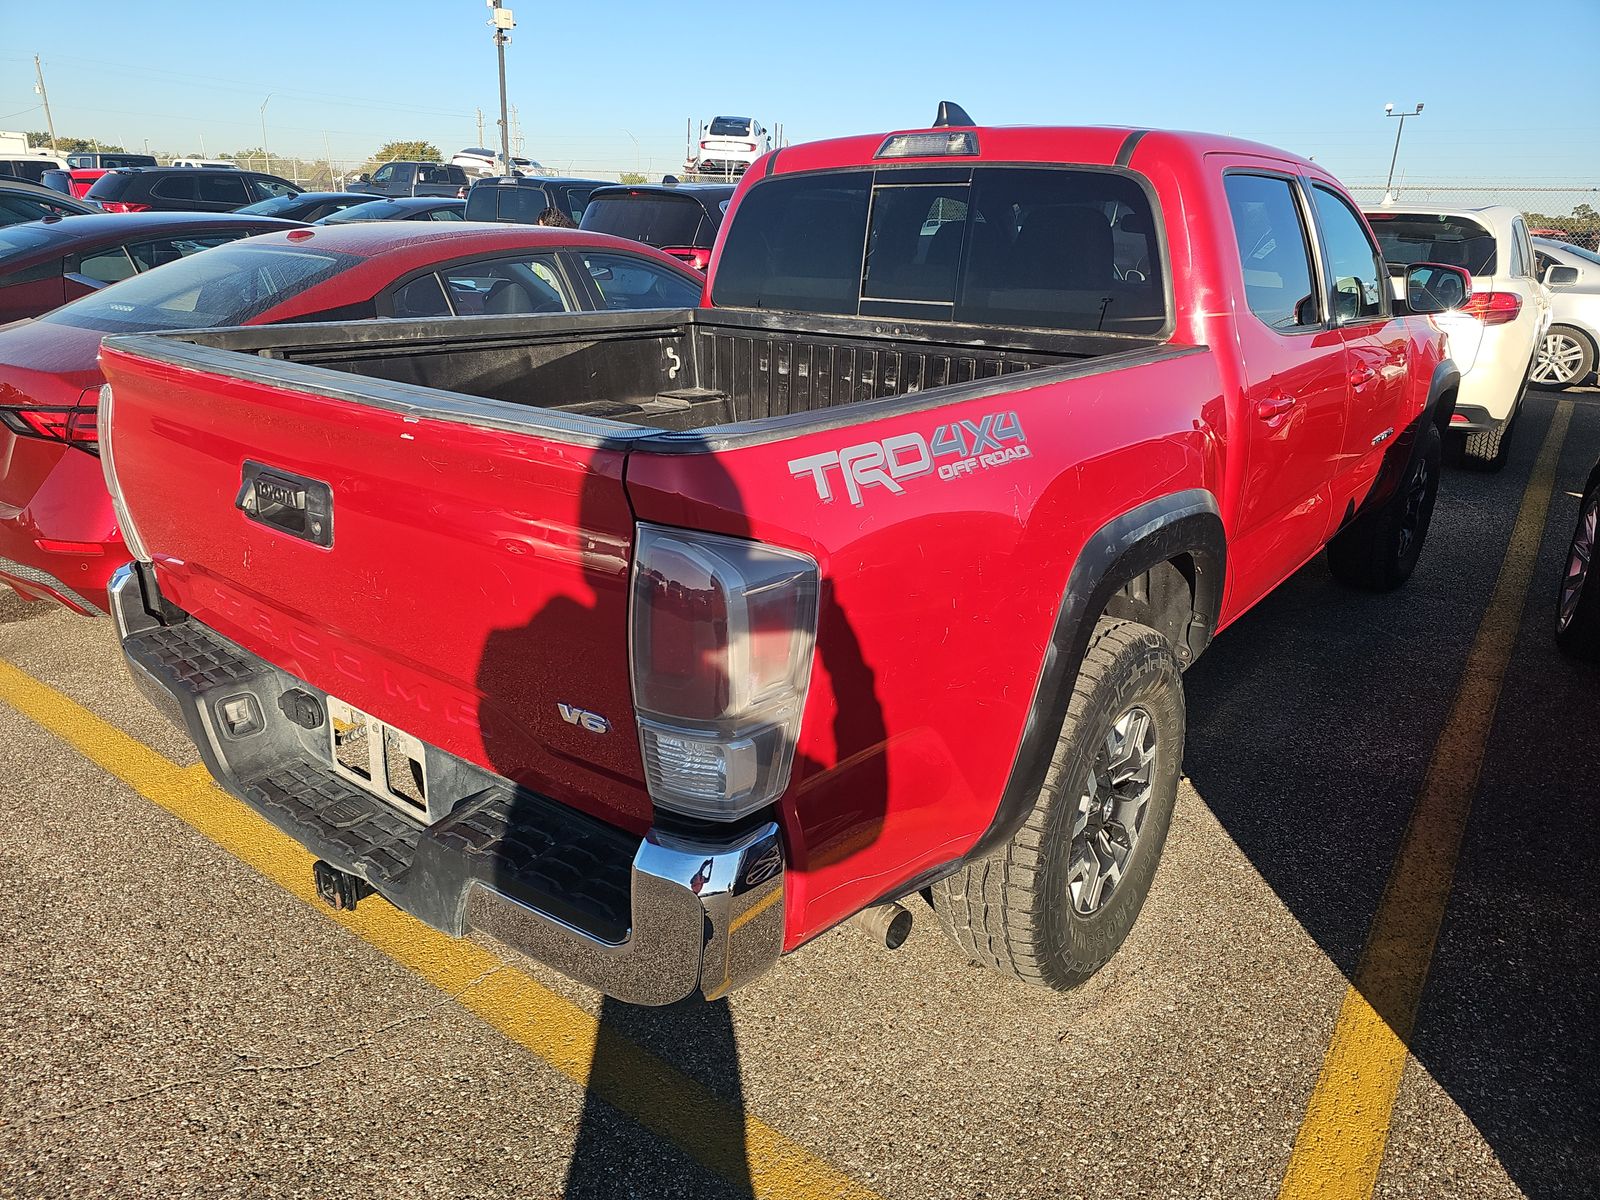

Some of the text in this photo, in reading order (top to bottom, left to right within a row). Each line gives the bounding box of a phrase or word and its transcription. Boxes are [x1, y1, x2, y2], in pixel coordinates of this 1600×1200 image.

[788, 411, 1028, 508] TRD 4X4
[938, 443, 1032, 482] OFF ROAD
[256, 480, 298, 509] TOYOTA
[556, 702, 612, 735] V6
